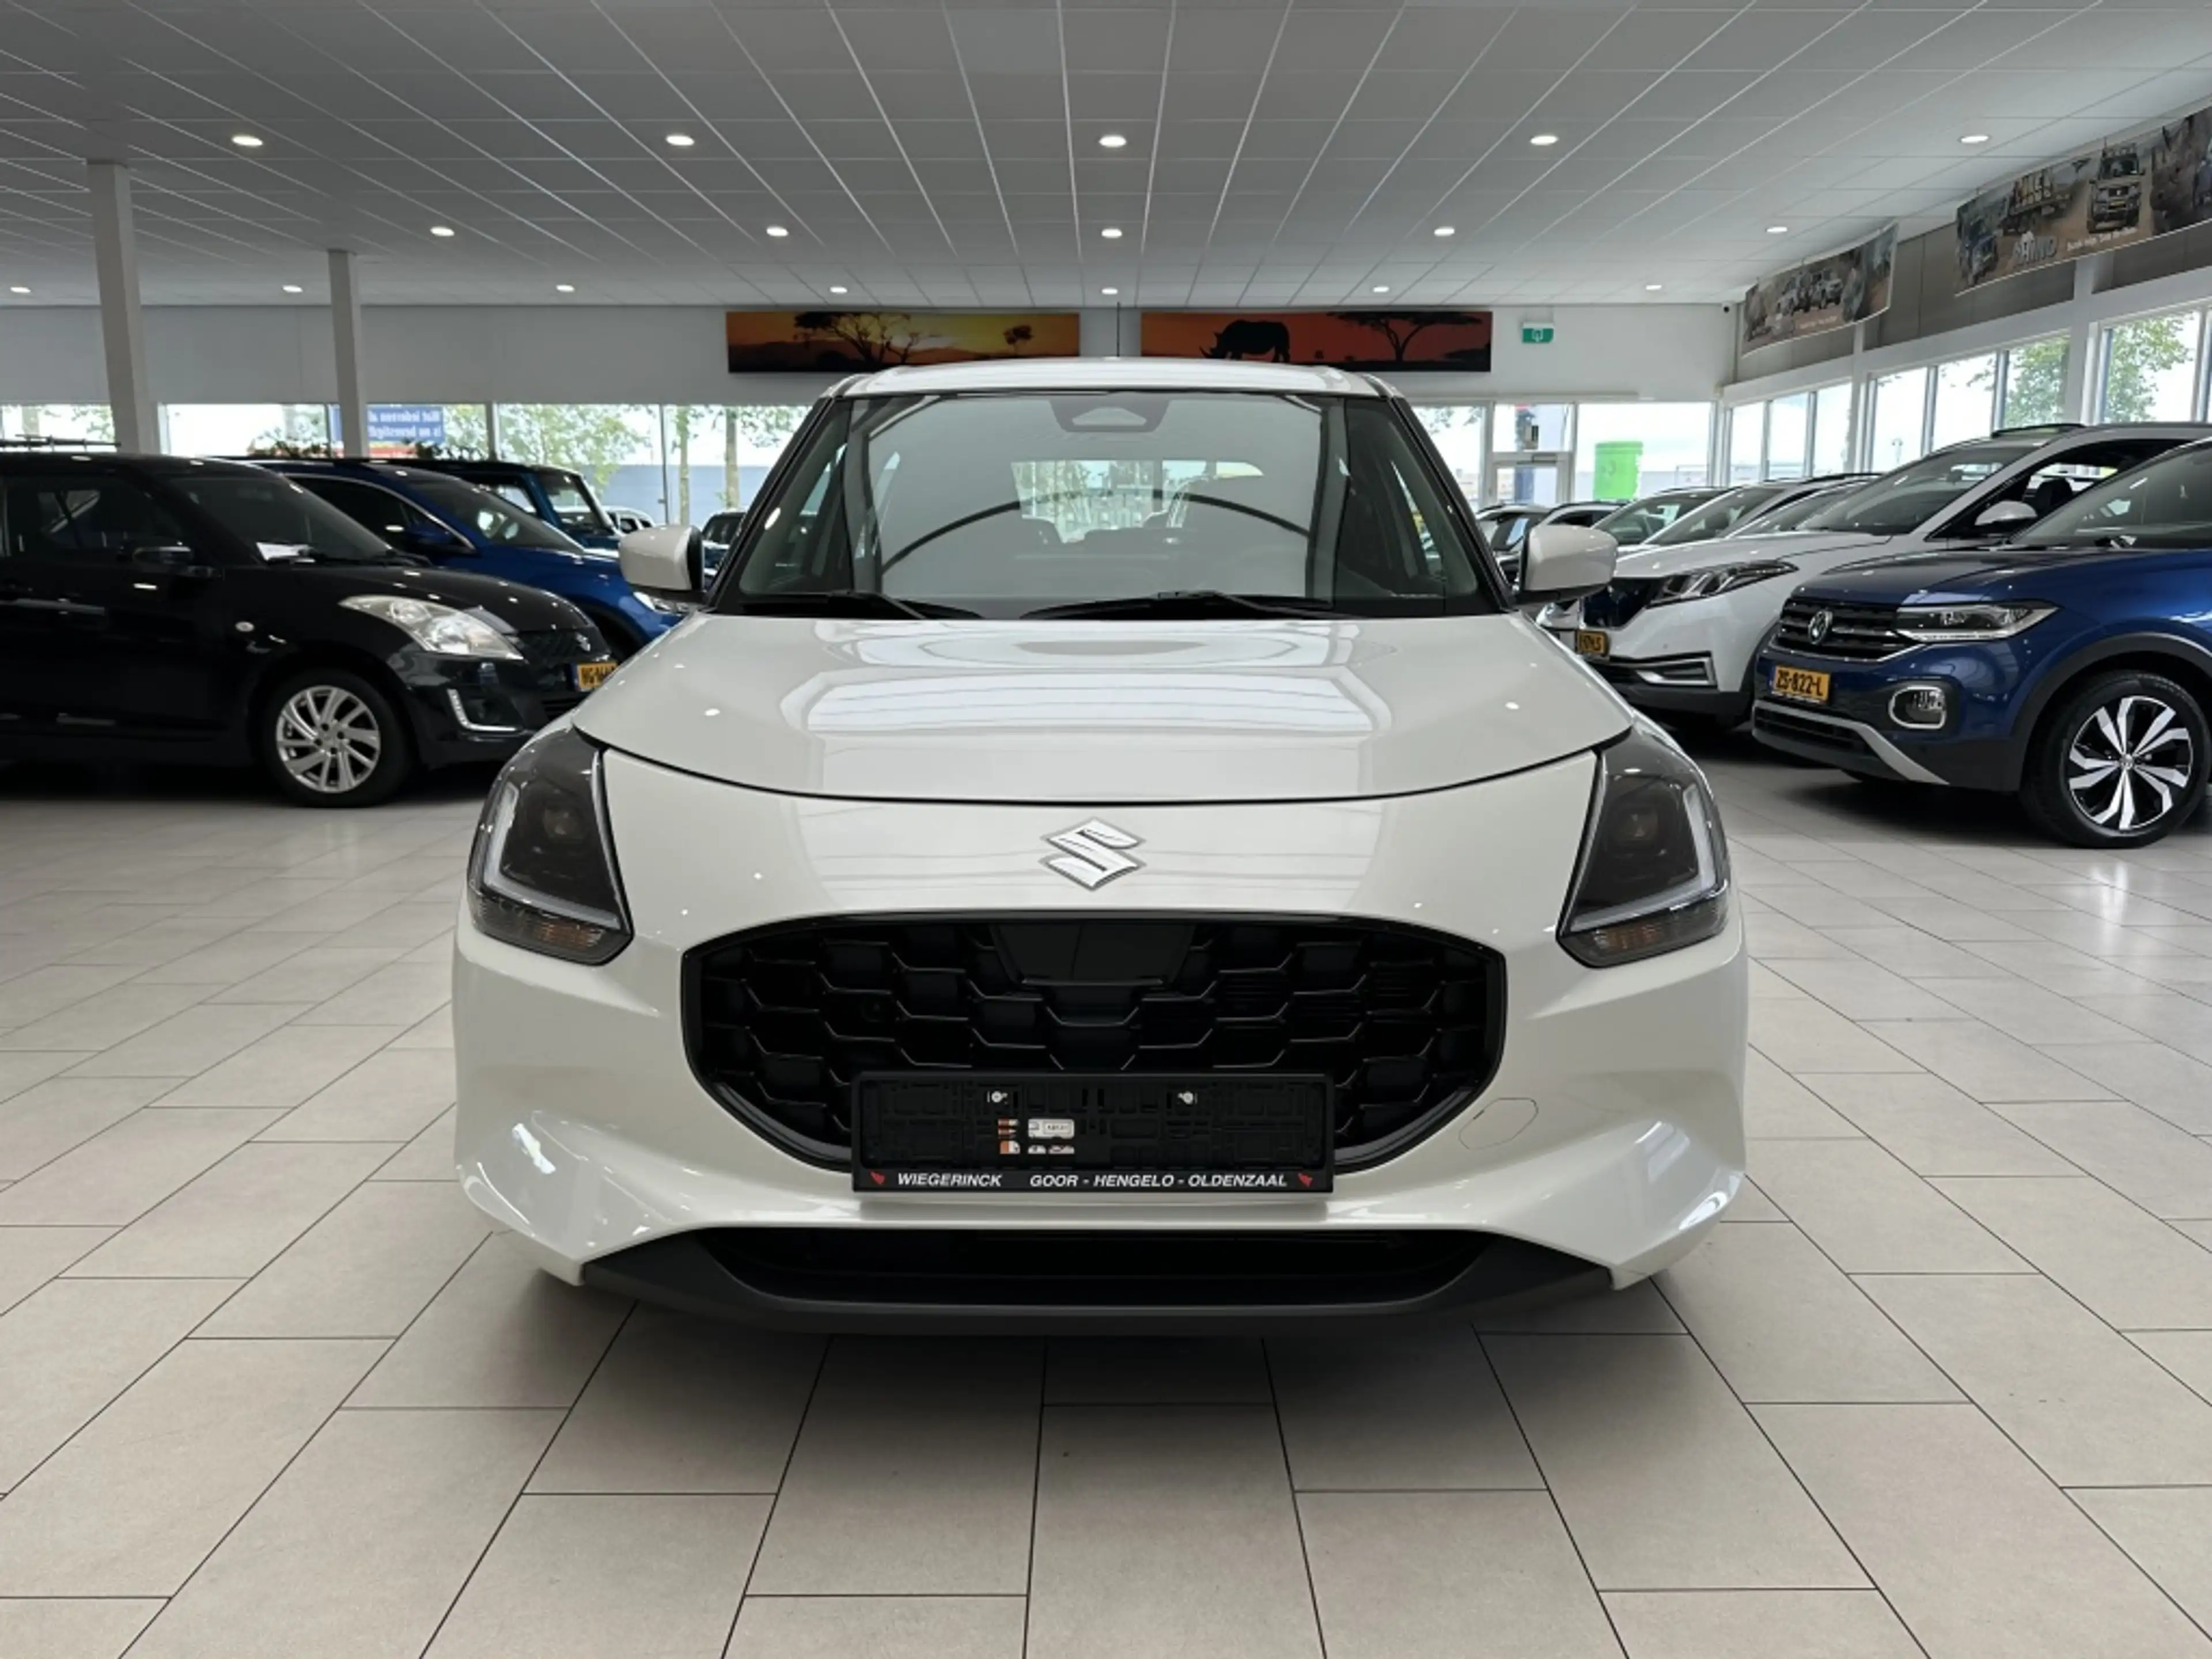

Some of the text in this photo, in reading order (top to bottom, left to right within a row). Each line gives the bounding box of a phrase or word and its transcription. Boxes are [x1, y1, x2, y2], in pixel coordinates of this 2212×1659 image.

[897, 1173, 1002, 1187] WIEGERINCK
[1030, 1175, 1078, 1187] GOOR
[1093, 1175, 1174, 1187] HENGELO
[1188, 1174, 1286, 1187] OLDENZAAL
